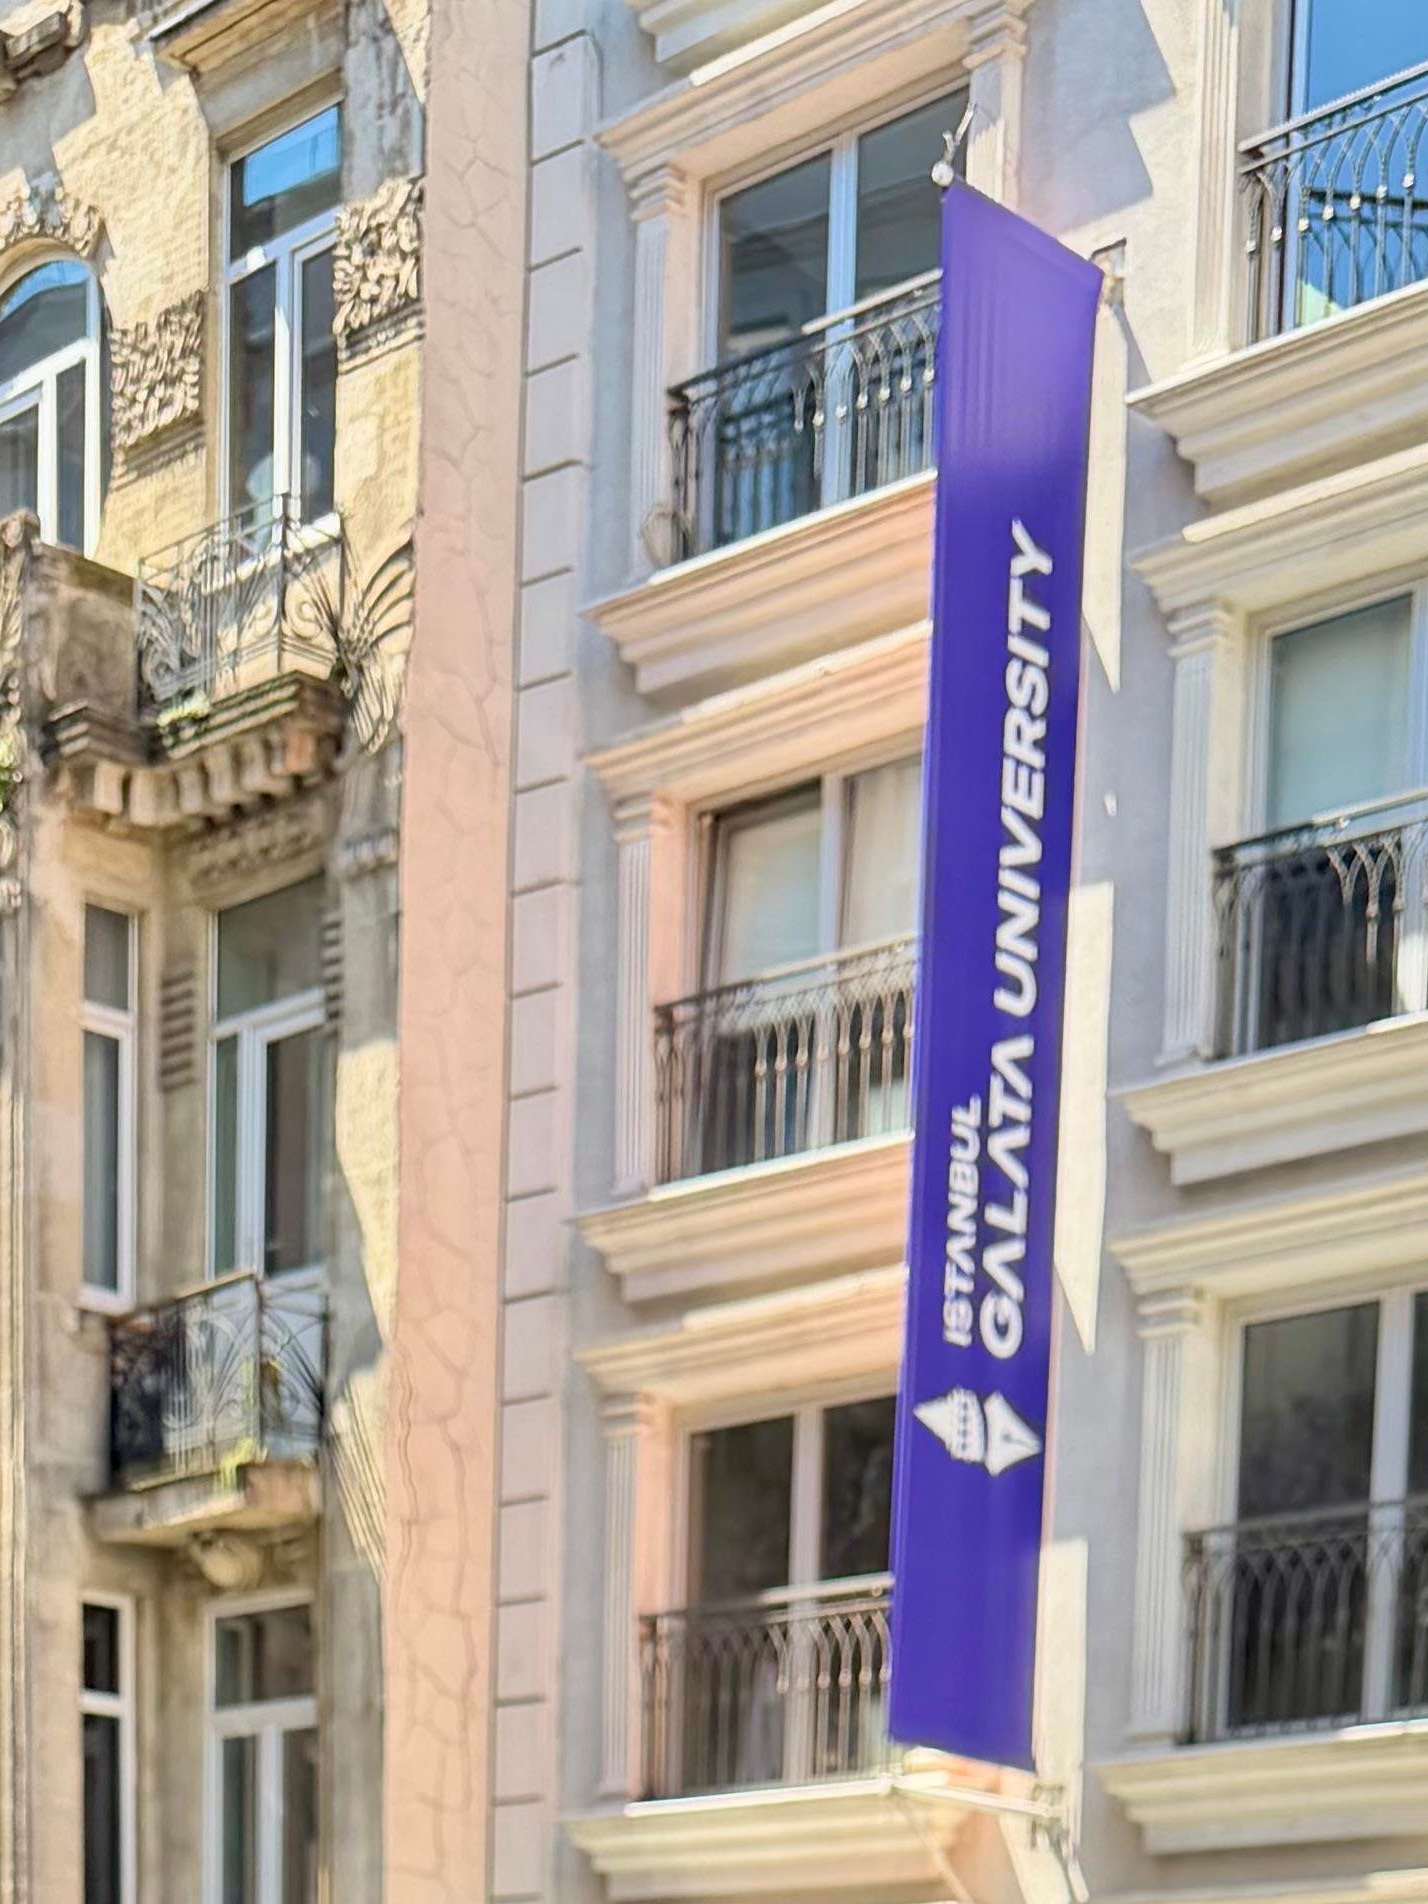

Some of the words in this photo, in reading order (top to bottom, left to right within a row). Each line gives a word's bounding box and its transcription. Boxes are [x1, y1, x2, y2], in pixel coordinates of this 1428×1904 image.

[992, 518, 1054, 1019] UNIVERSITY
[941, 1095, 982, 1348] ISTANBUL
[978, 1033, 1036, 1361] GALATA
